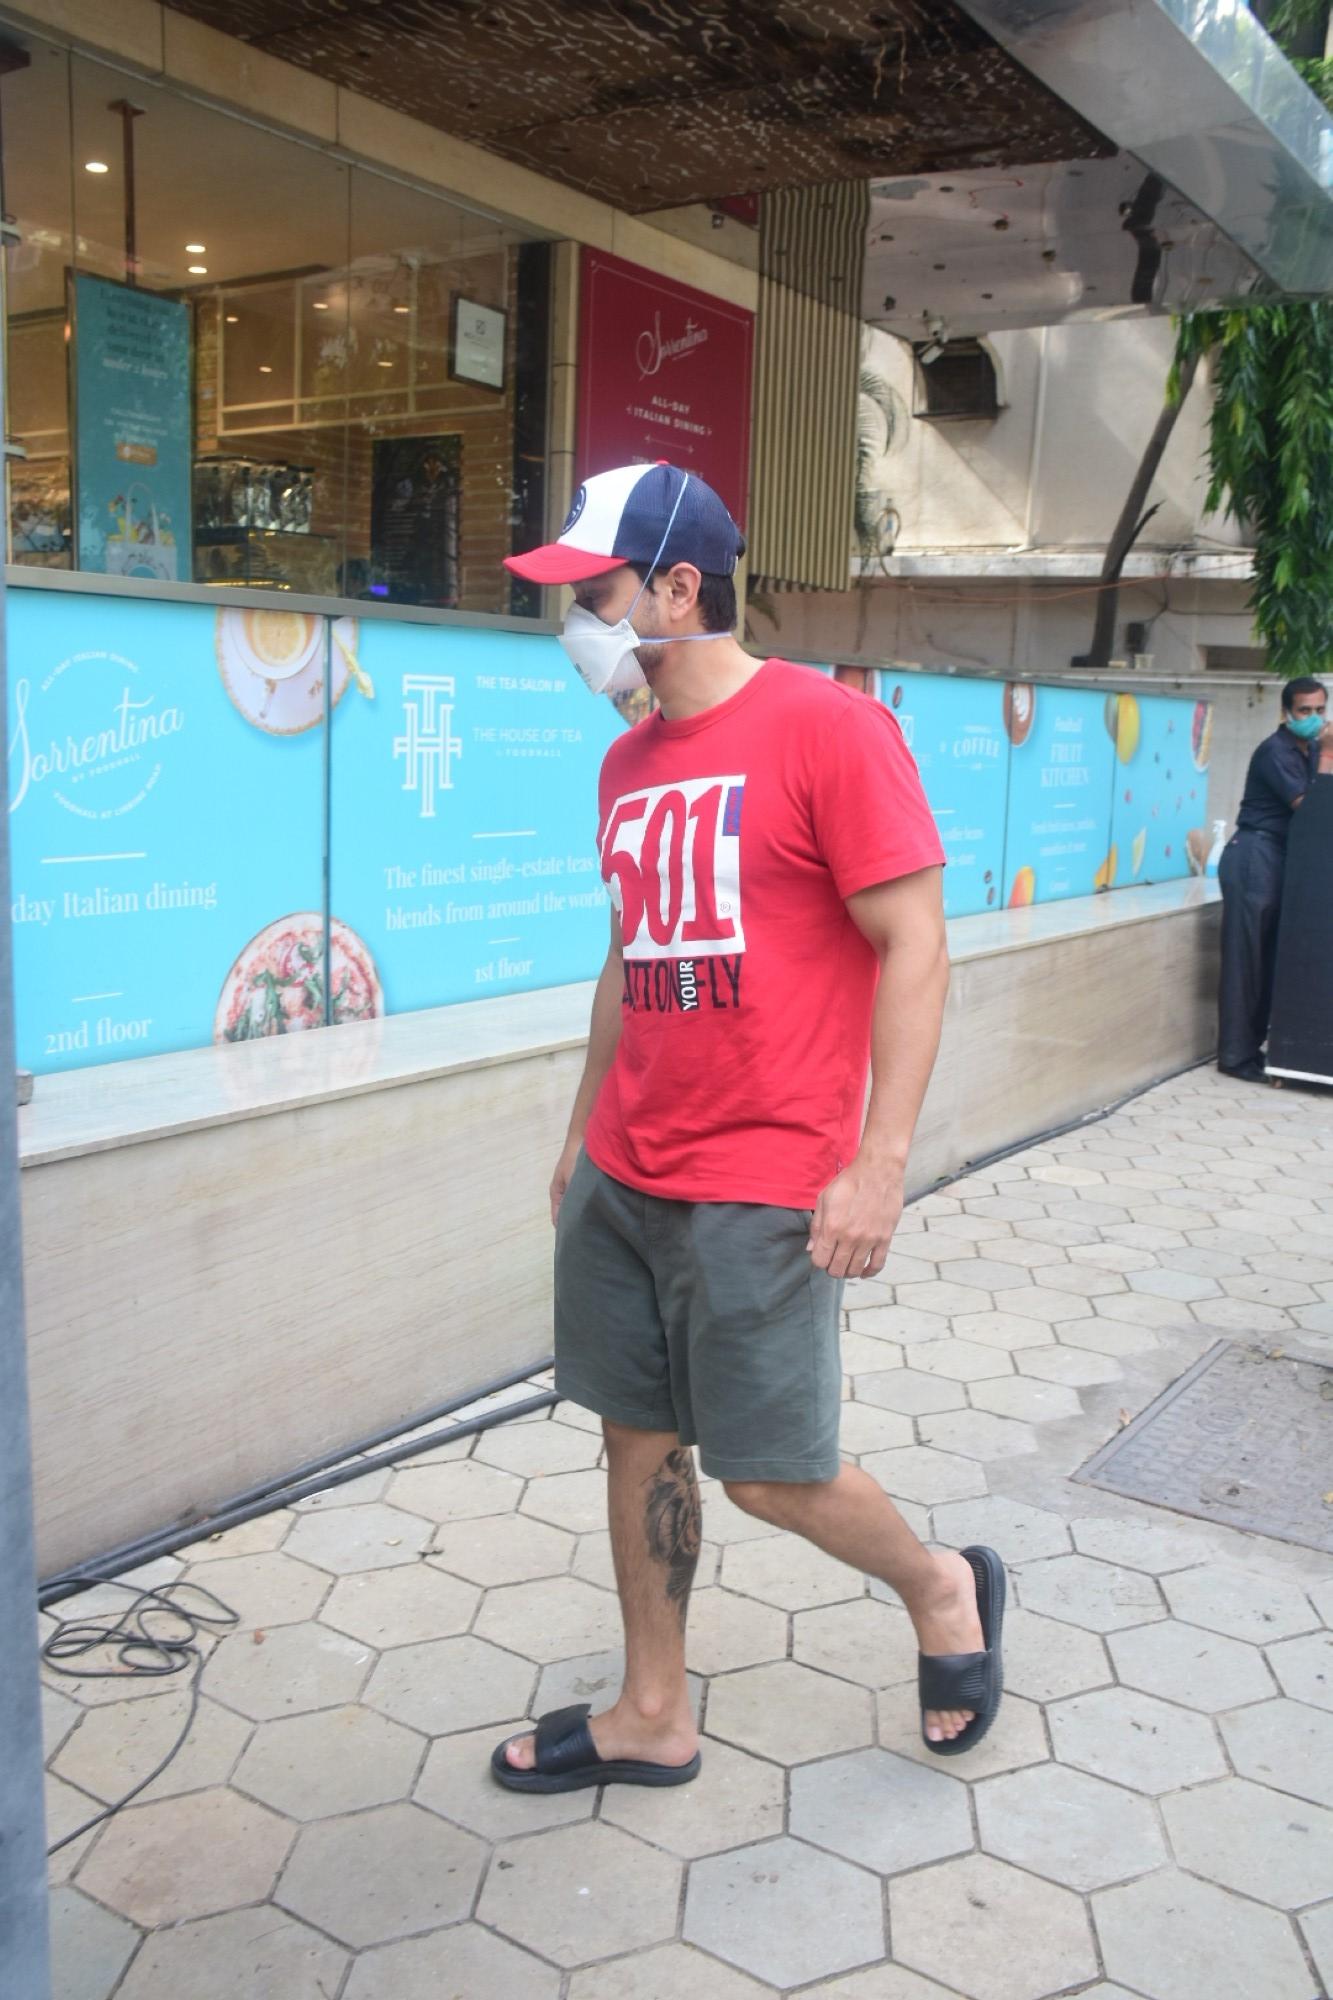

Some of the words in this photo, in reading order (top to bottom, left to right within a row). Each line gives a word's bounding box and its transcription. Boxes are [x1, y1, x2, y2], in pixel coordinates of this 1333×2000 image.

[651, 395, 691, 415] ALL-DAY
[633, 407, 671, 426] ITALIAN
[674, 419, 706, 436] DINING
[475, 675, 497, 690] THE
[499, 676, 518, 691] TEA
[519, 678, 553, 692] SALON
[554, 679, 567, 693] BY
[7, 678, 184, 814] Sorrentina
[472, 726, 497, 742] THE
[499, 727, 541, 743] HOUSE
[543, 728, 560, 743] OF
[560, 728, 583, 743] TEA
[953, 736, 1000, 758] COFFEE
[1050, 743, 1084, 763] FRUIT
[1040, 766, 1090, 788] KITCHEN
[384, 865, 417, 889] The
[421, 862, 466, 886] finest
[470, 856, 563, 885] single-estate
[567, 854, 594, 873] teas
[602, 783, 736, 947] 501
[63, 887, 139, 919] Italian
[146, 881, 217, 910] dining
[385, 903, 441, 931] blends
[445, 900, 484, 924] from
[488, 892, 540, 919] around
[543, 890, 565, 912] the
[474, 962, 494, 984] 1st
[499, 957, 533, 979] floor
[680, 960, 698, 1011] YOUR
[695, 953, 743, 1010] FLY
[44, 1020, 89, 1055] 2nd
[96, 1017, 153, 1046] floor
